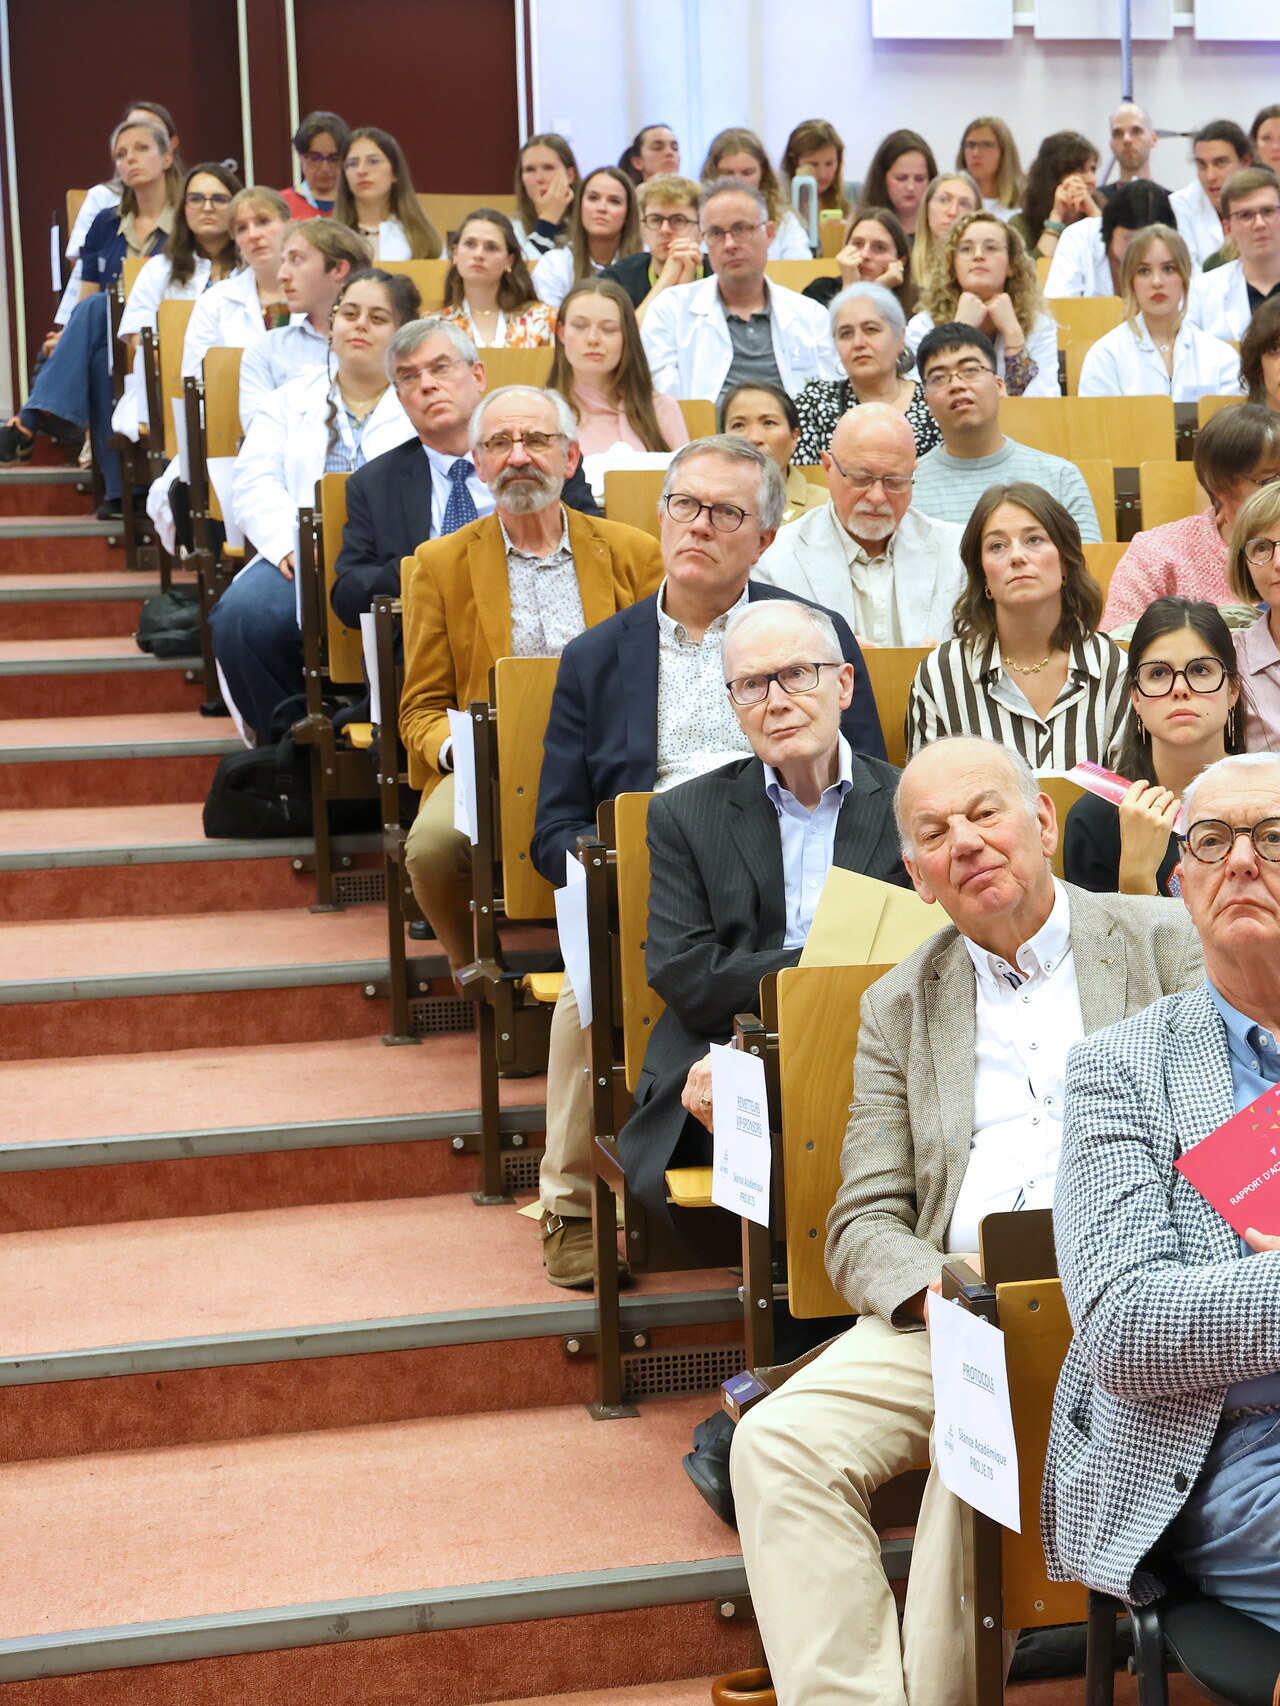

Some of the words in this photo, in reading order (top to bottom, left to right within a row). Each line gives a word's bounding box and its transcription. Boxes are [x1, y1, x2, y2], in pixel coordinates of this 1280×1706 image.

[736, 1115, 762, 1135] VIP-SPONSORS
[740, 1192, 755, 1206] PROJETS
[1229, 1176, 1263, 1205] RAPPORT
[963, 1363, 994, 1391] PROTOCOLE
[958, 1428, 974, 1448] Séance
[974, 1437, 1006, 1466] Académique
[970, 1456, 994, 1480] PROJETS
